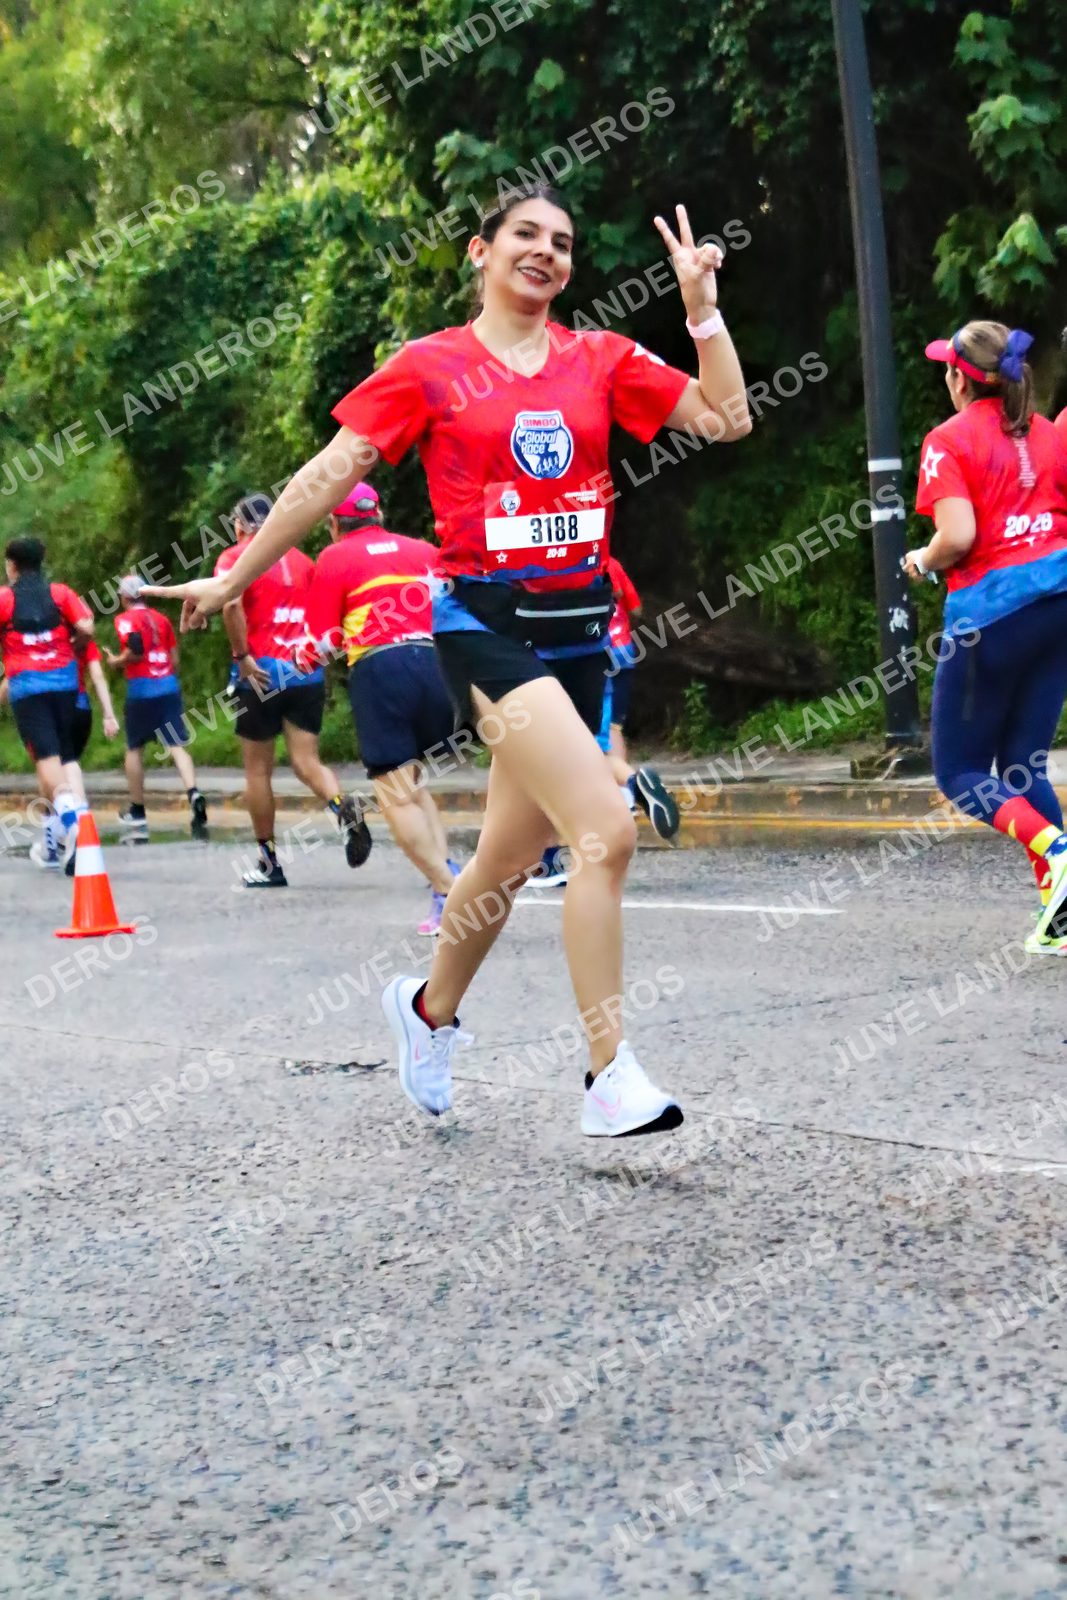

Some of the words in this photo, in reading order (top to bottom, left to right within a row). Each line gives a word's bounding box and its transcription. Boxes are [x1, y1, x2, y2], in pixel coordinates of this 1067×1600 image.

[522, 418, 557, 427] BIMBO
[525, 430, 557, 444] Global
[521, 441, 545, 455] Race
[530, 514, 578, 544] 3188
